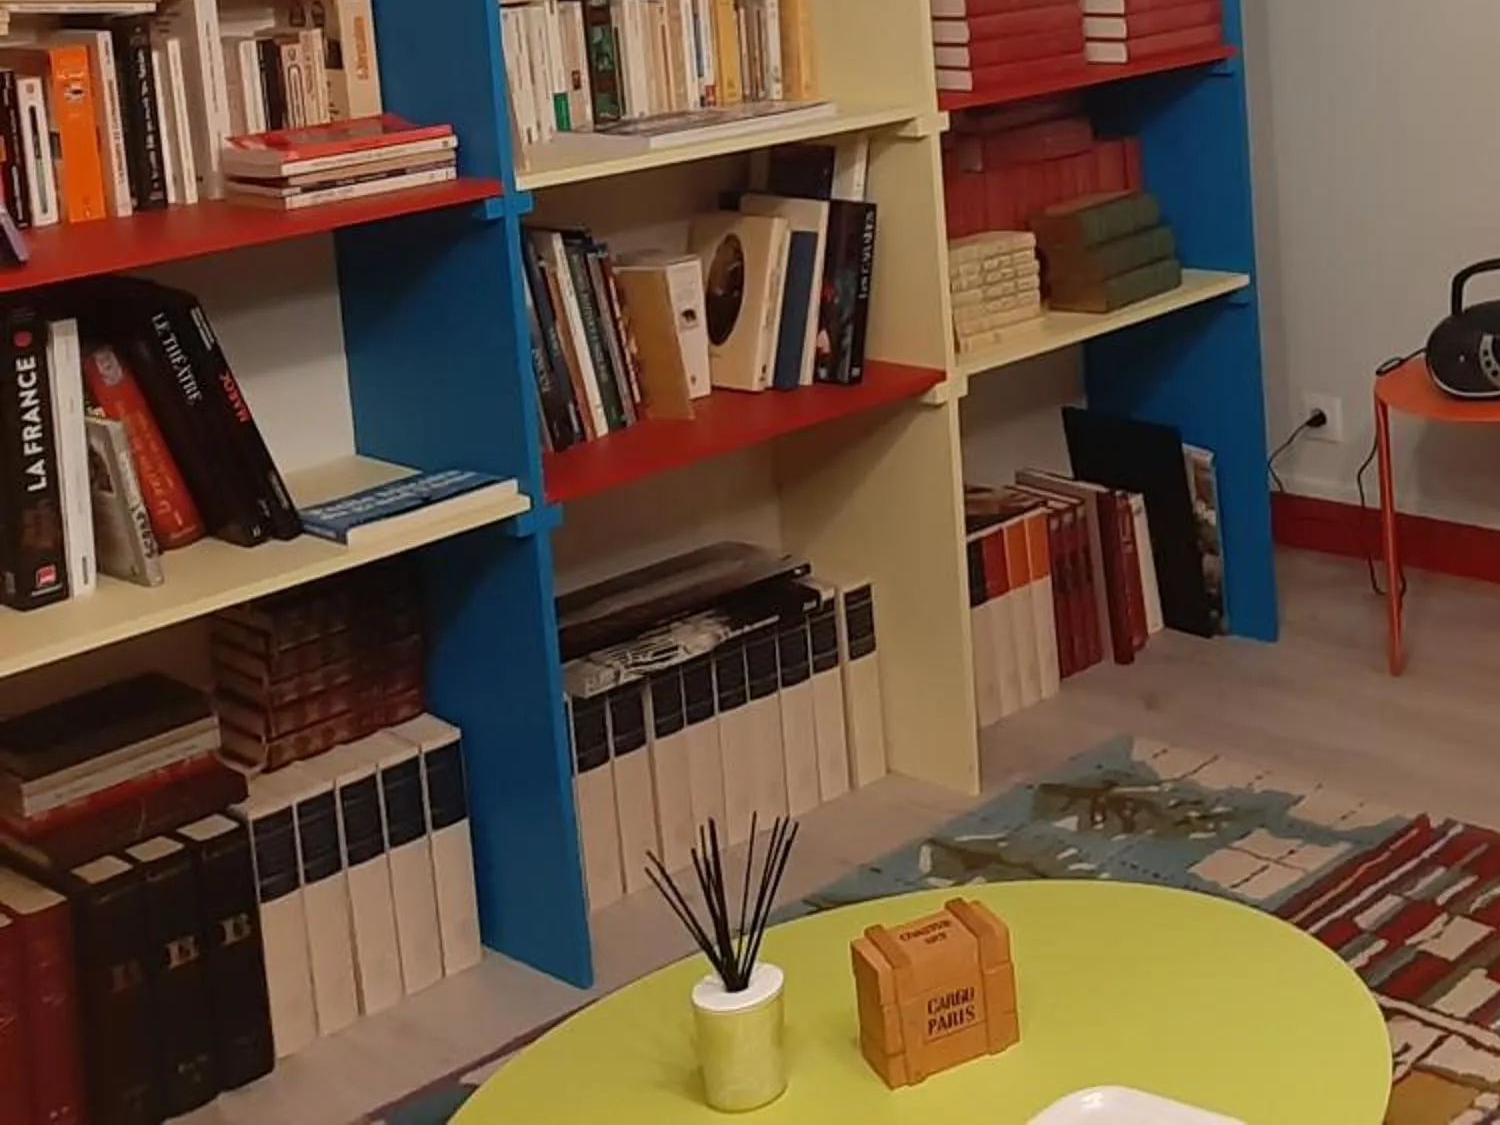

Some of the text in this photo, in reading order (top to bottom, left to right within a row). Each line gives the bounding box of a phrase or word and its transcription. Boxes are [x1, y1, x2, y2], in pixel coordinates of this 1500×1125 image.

[15, 355, 48, 493] LA FRANCE
[927, 986, 975, 1016] CARGO
[927, 1004, 976, 1036] PARIS
